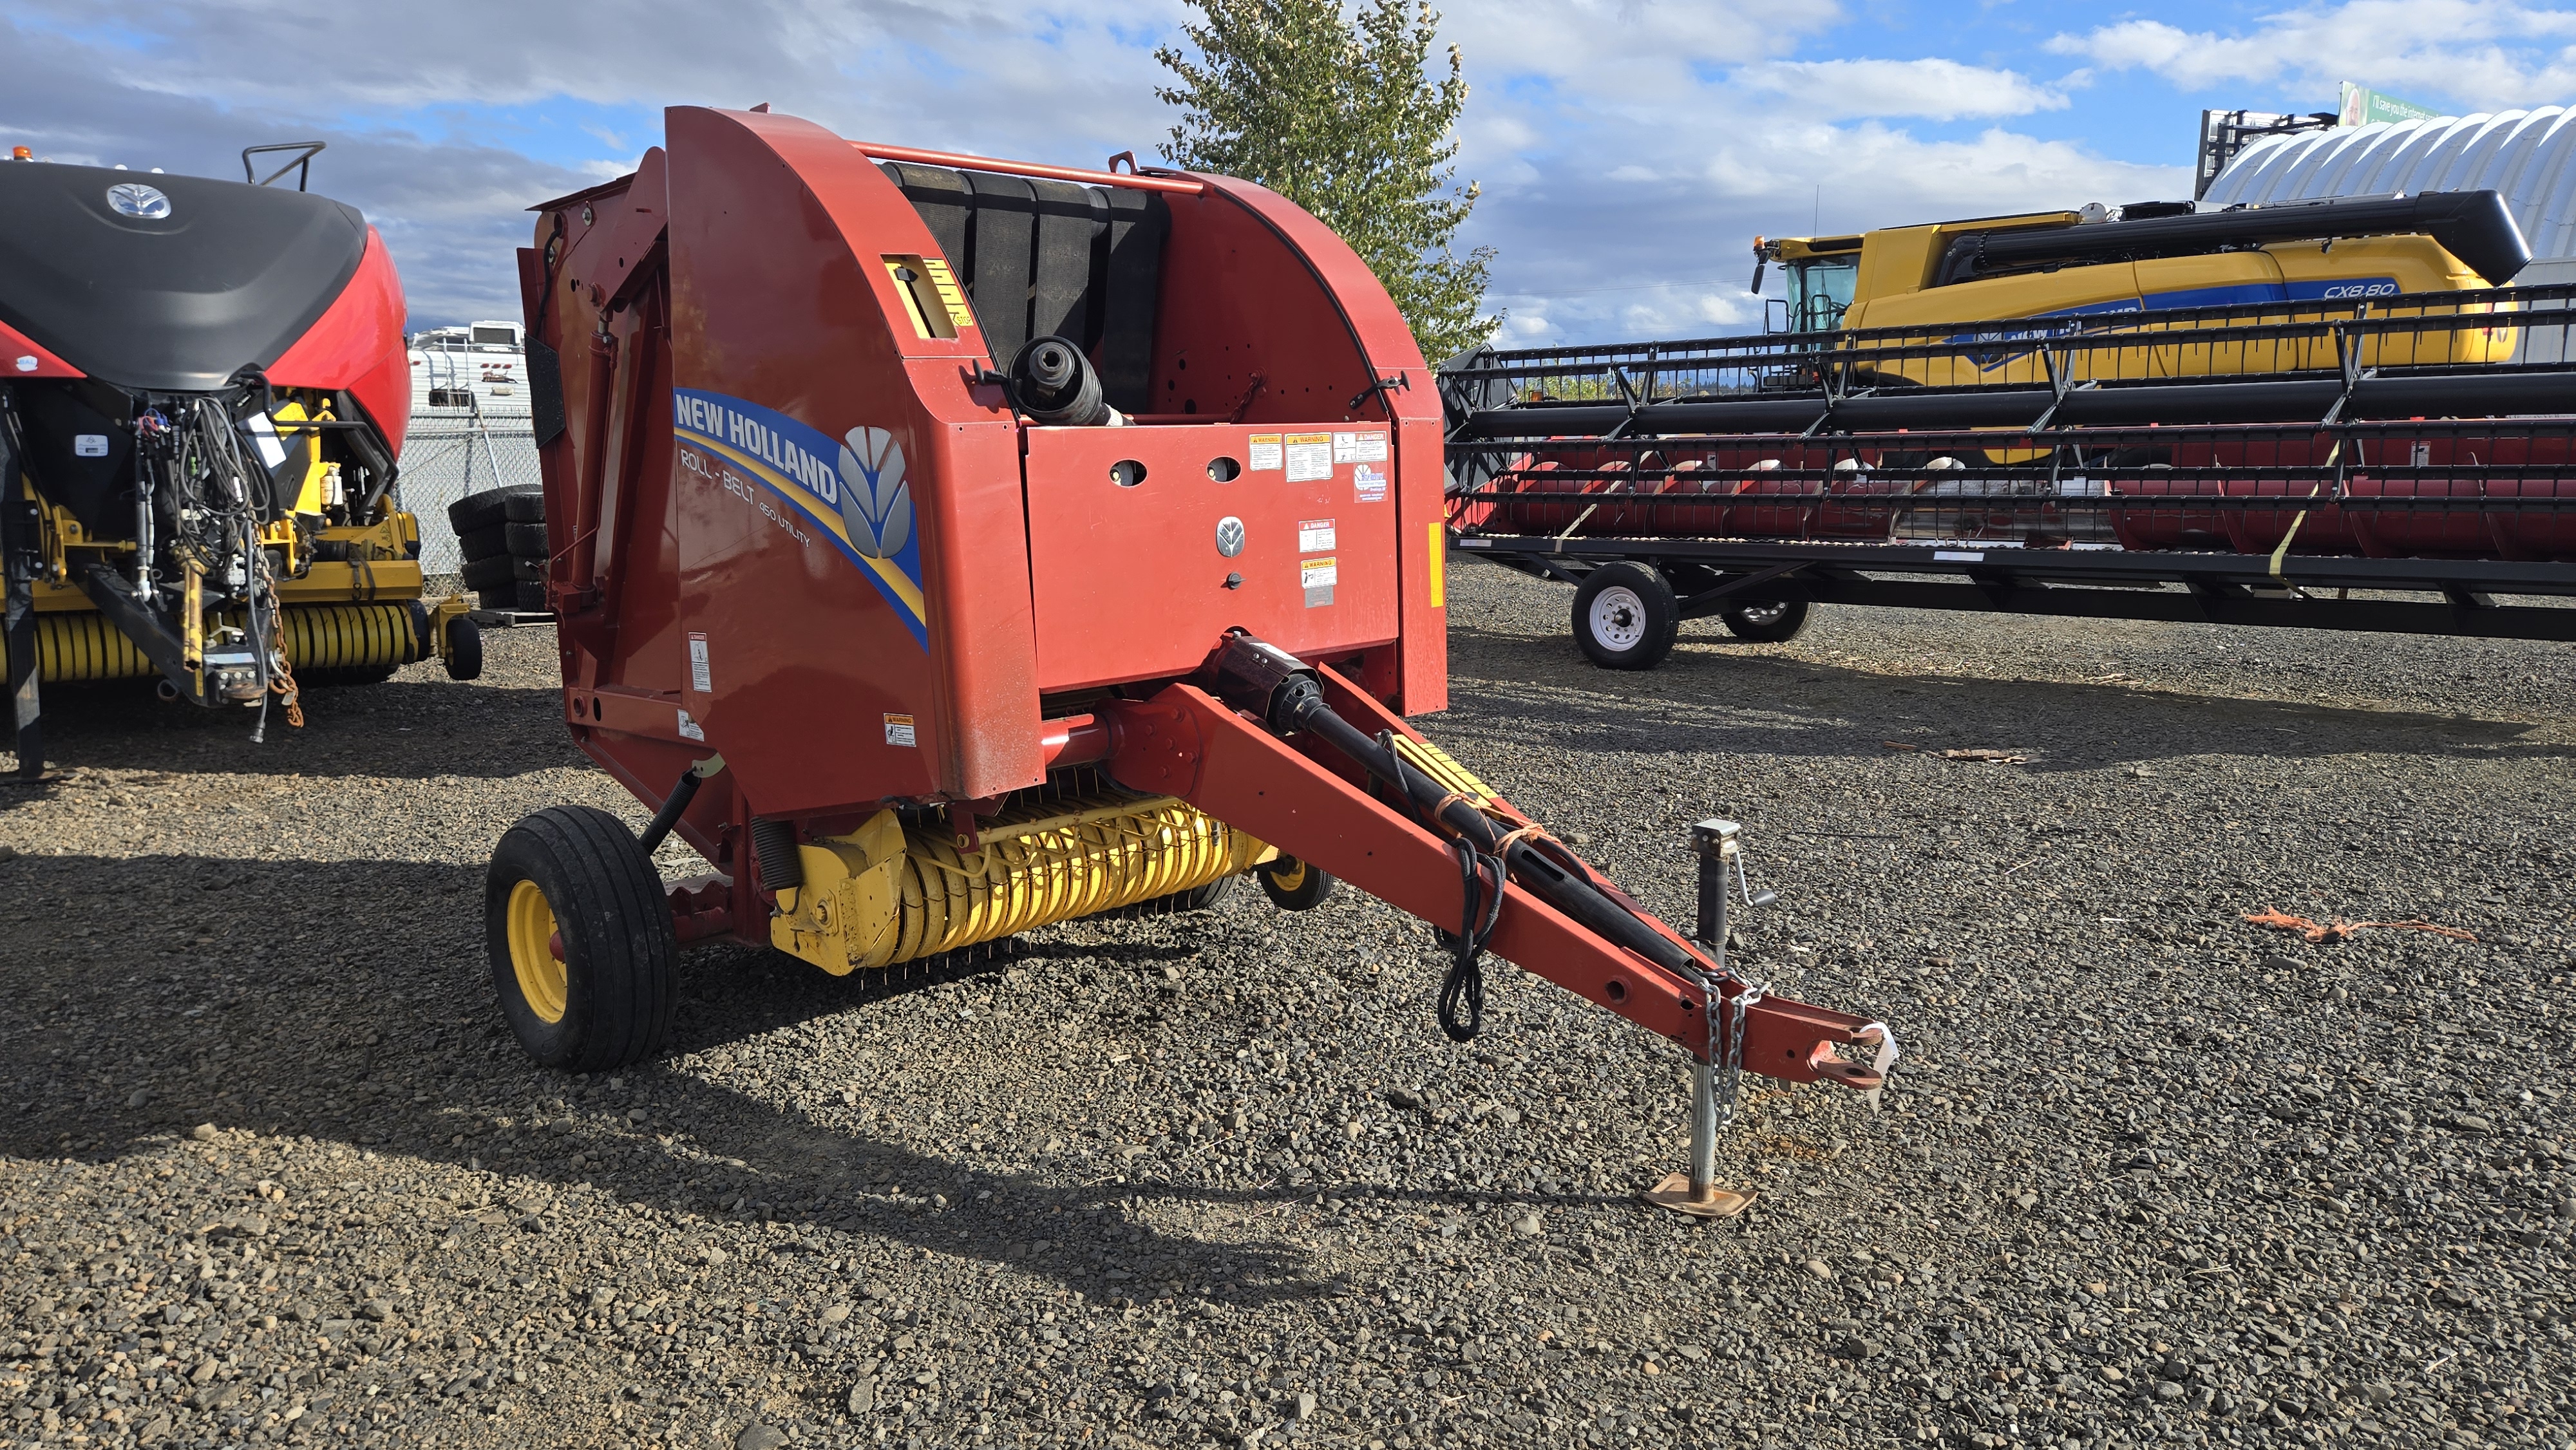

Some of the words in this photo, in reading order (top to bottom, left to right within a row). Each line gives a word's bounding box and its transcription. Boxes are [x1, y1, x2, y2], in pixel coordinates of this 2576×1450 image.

[2380, 100, 2390, 112] save
[2390, 104, 2400, 116] you
[2400, 103, 2408, 117] the
[2408, 106, 2425, 120] internet
[676, 394, 723, 438] NEW
[728, 410, 837, 504] HOLLAND
[681, 449, 712, 480] ROLL
[723, 469, 754, 505] BELT
[759, 502, 776, 521] 450
[778, 514, 810, 547] UTILITY
